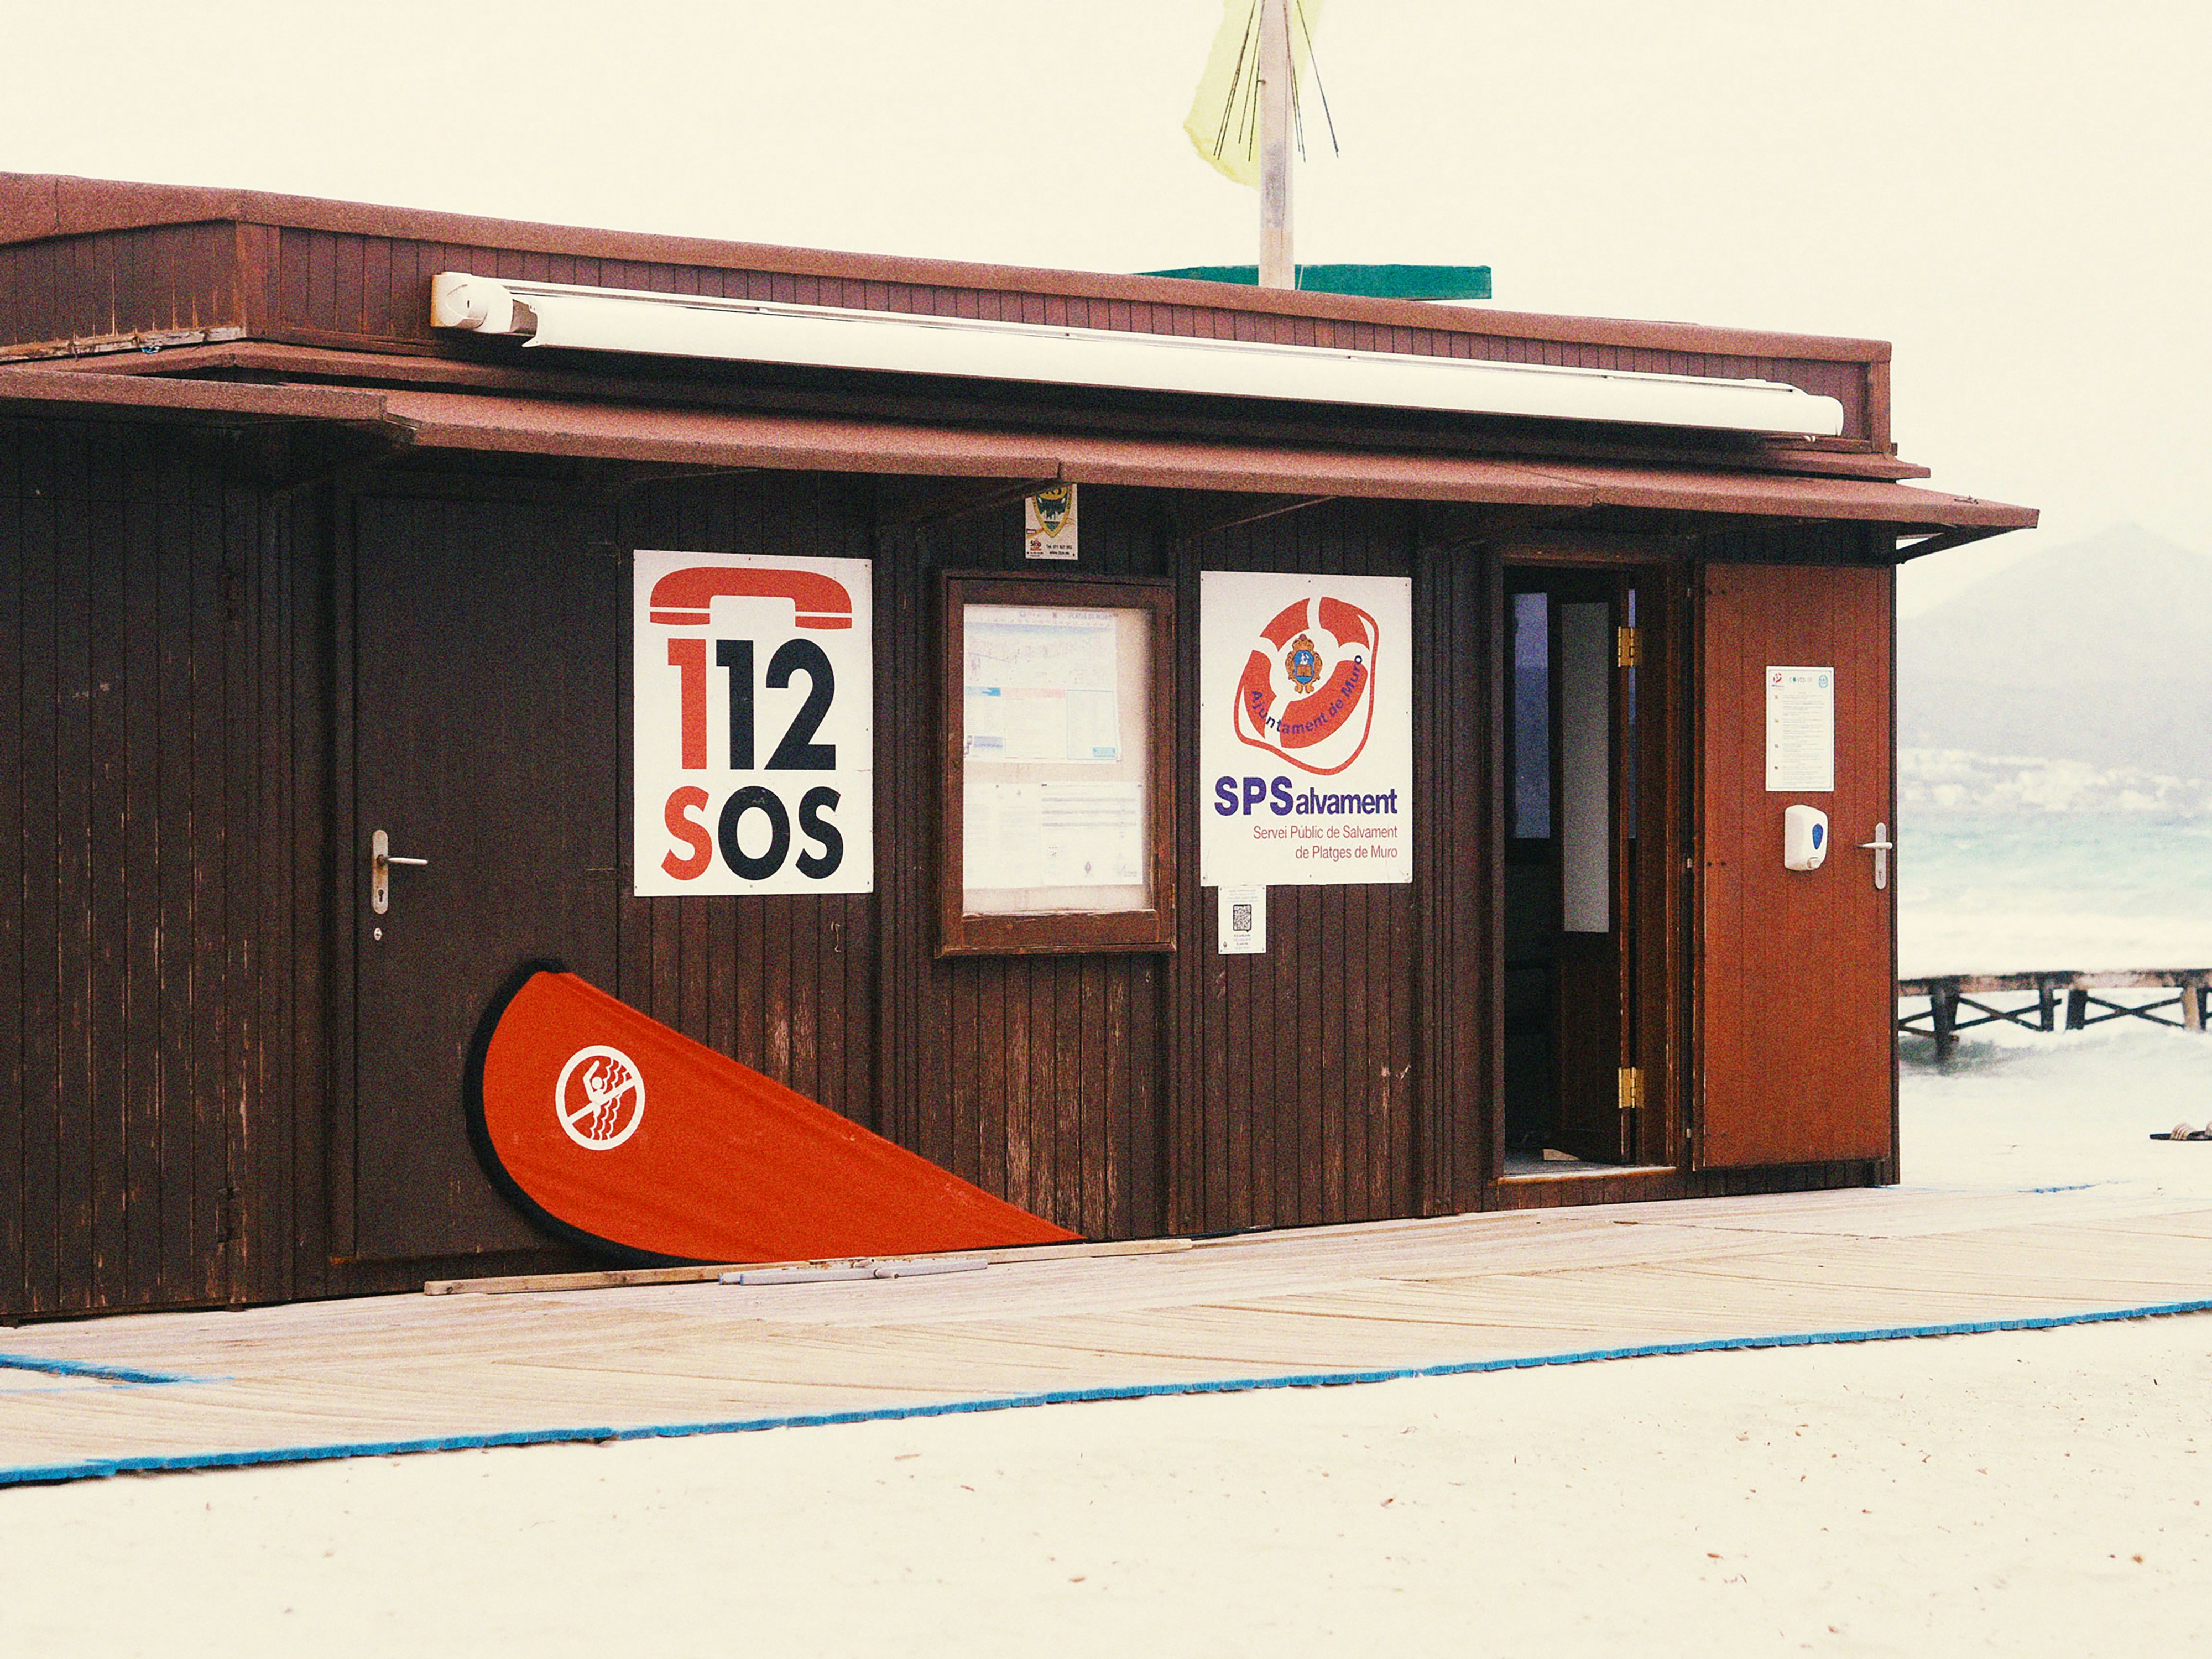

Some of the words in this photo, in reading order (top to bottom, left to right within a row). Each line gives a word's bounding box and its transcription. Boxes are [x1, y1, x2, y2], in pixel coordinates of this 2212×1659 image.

[668, 638, 836, 770] 112
[1251, 690, 1328, 734] Ajuntament
[1328, 698, 1344, 716] de
[1341, 655, 1362, 697] Muro
[1214, 776, 1397, 816] SPSalvament
[661, 785, 843, 880] SOS
[1253, 825, 1287, 839] Servei
[1291, 825, 1323, 839] Públic
[1327, 826, 1340, 838] de
[1343, 825, 1397, 838] Salvament
[1296, 845, 1309, 859] de
[1313, 845, 1352, 862] Platges
[1354, 845, 1368, 858] de
[1371, 844, 1398, 858] Muro
